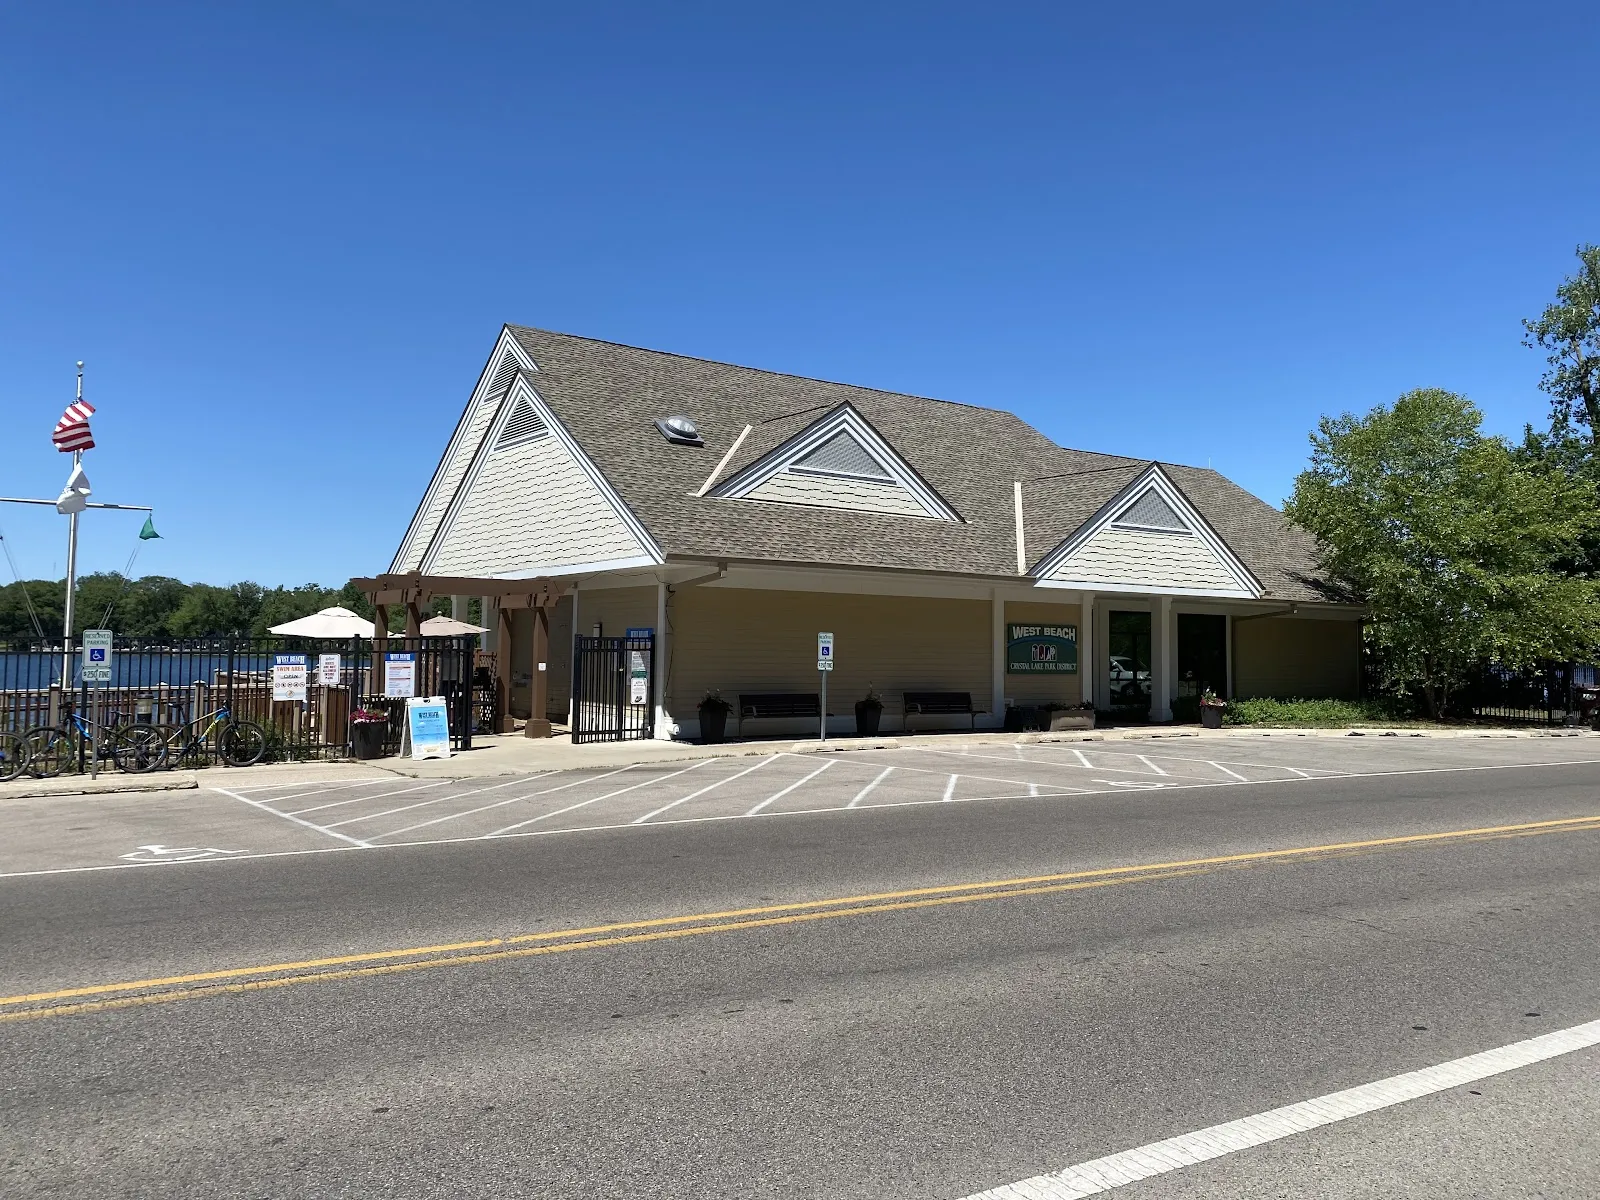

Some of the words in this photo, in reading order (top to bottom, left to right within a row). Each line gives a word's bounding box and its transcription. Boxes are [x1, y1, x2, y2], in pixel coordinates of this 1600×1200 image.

[1012, 626, 1041, 640] WEST
[1044, 627, 1076, 642] BEACH
[276, 656, 290, 664] WEST
[290, 656, 305, 664] BEACH
